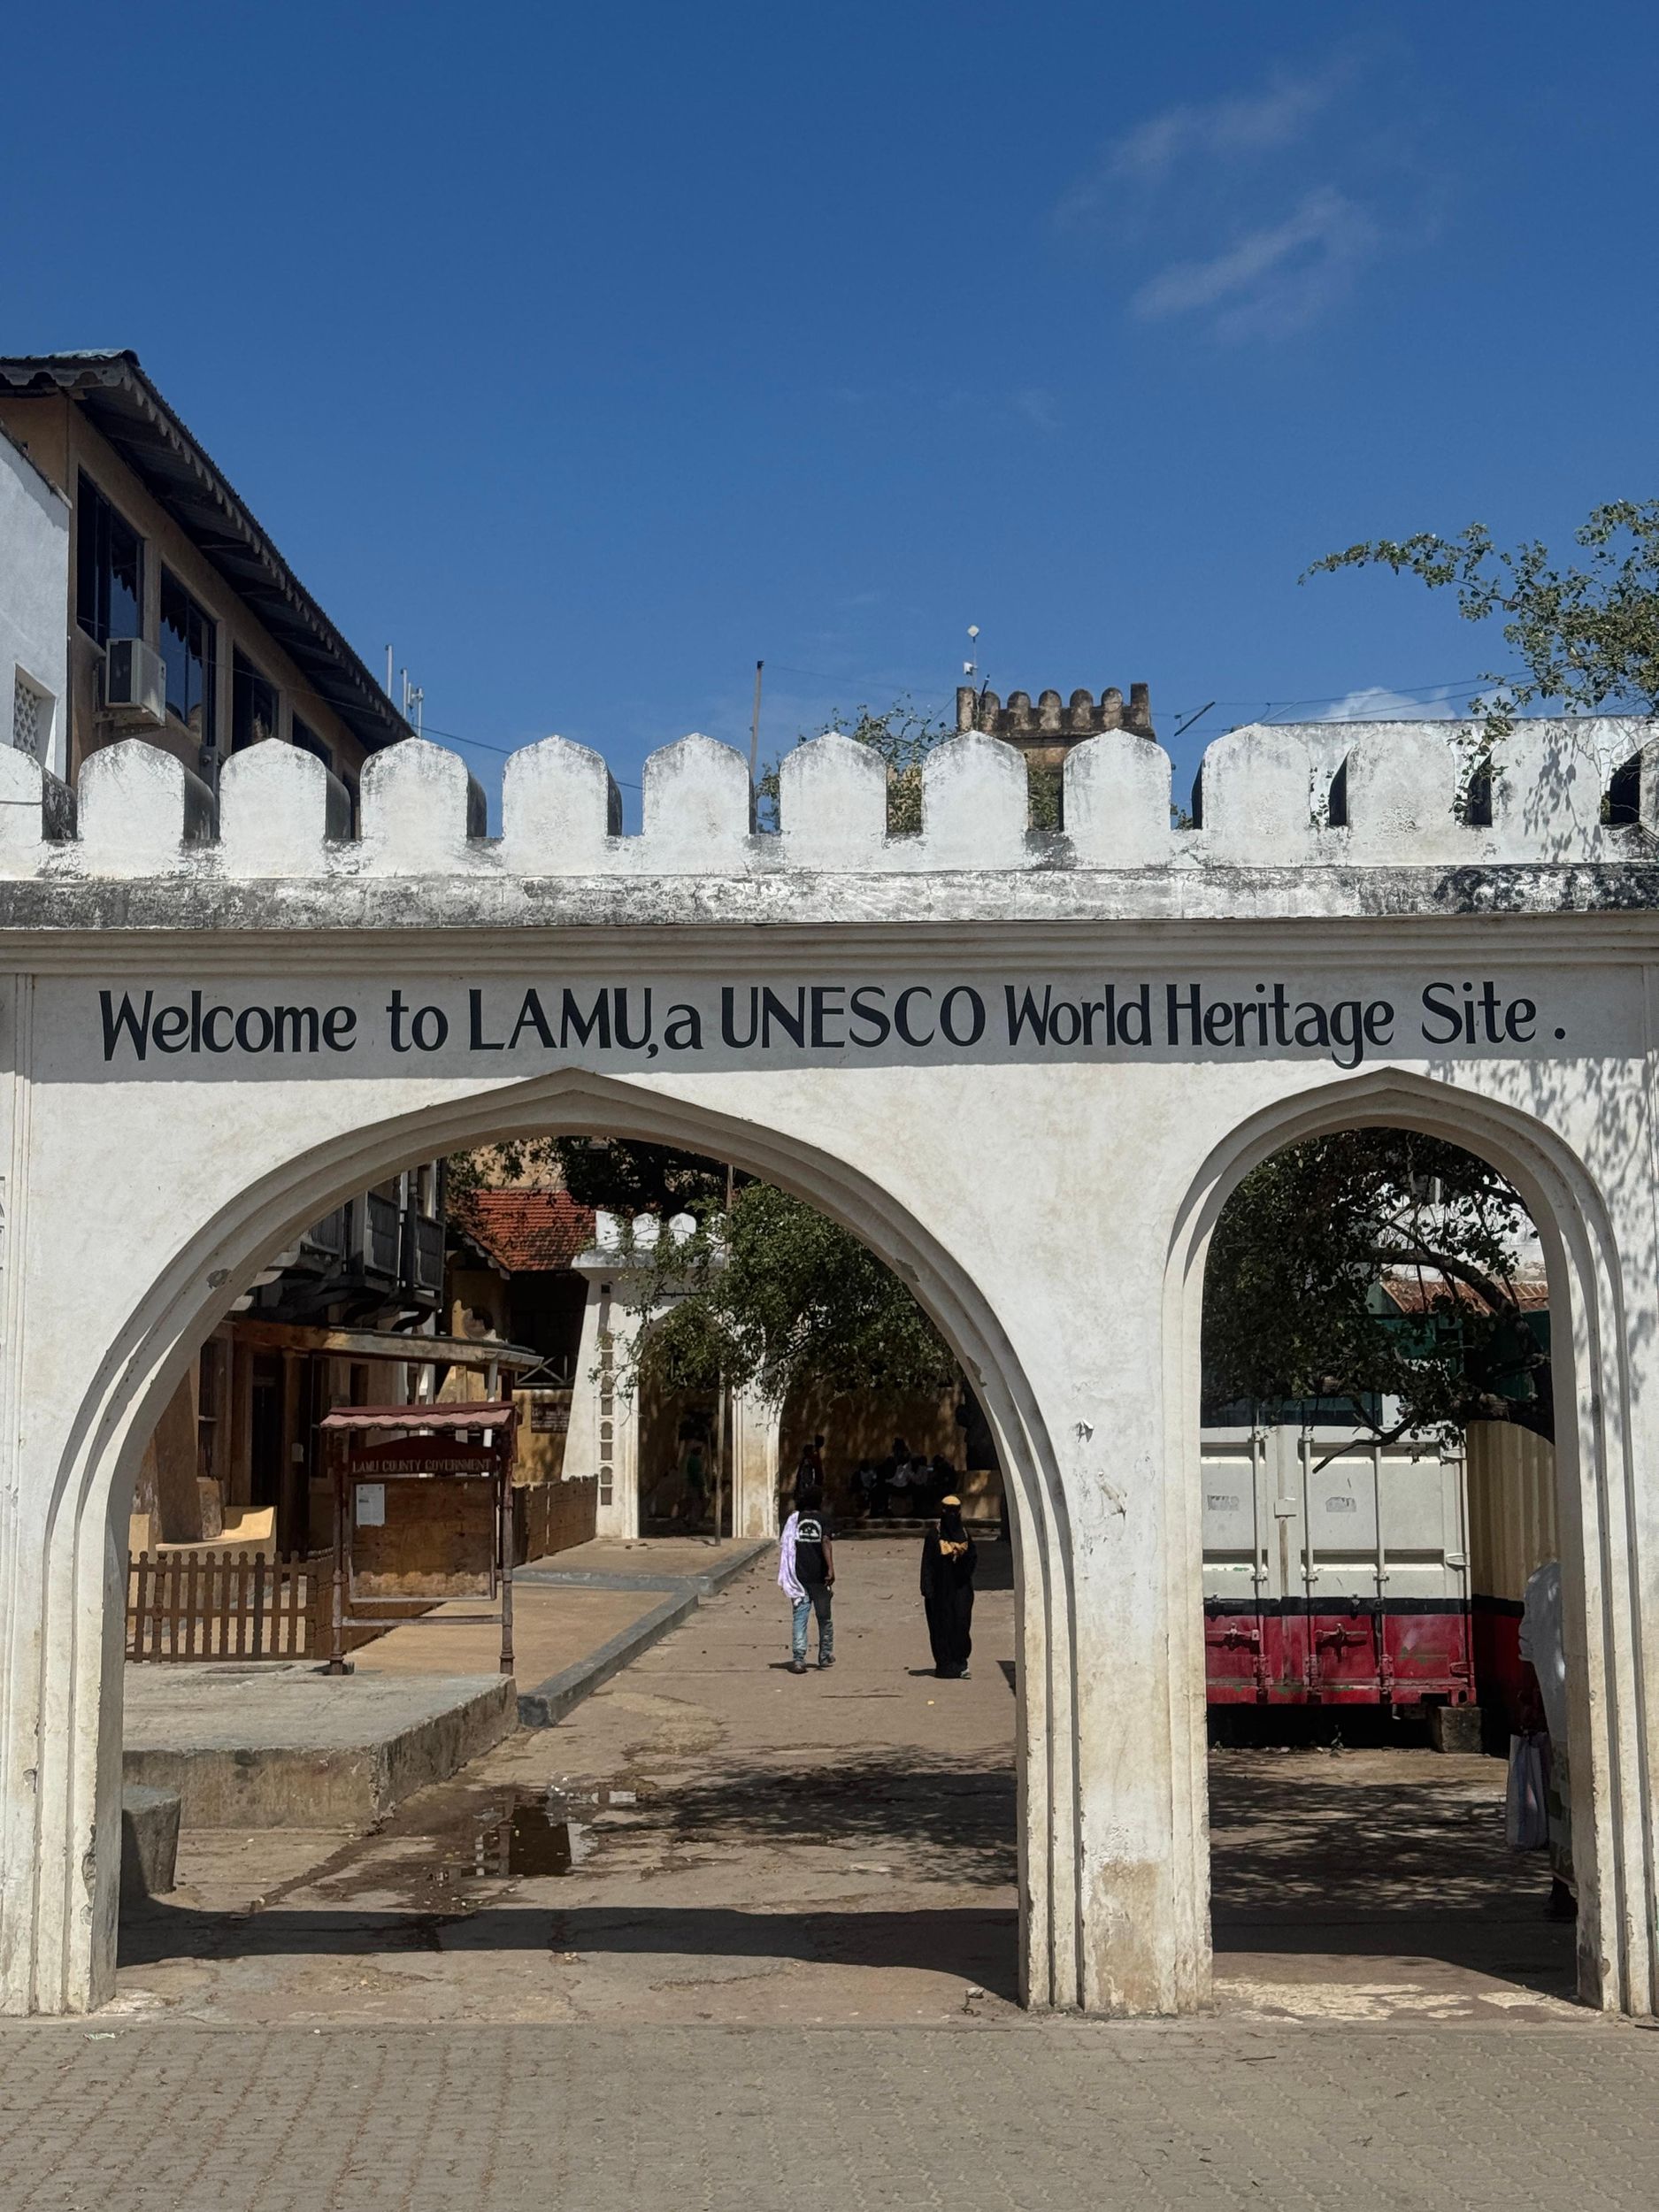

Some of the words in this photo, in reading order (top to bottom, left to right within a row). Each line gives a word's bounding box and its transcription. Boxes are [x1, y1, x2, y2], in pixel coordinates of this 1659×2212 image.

[98, 989, 357, 1062] Welcome
[385, 989, 449, 1053] to
[721, 985, 987, 1049] UNESCO
[1003, 984, 1152, 1047] World
[1165, 983, 1395, 1071] Heritage
[352, 1460, 380, 1473] LAMU
[381, 1459, 421, 1472] COUNTY
[424, 1458, 492, 1471] GOVERNMENT
